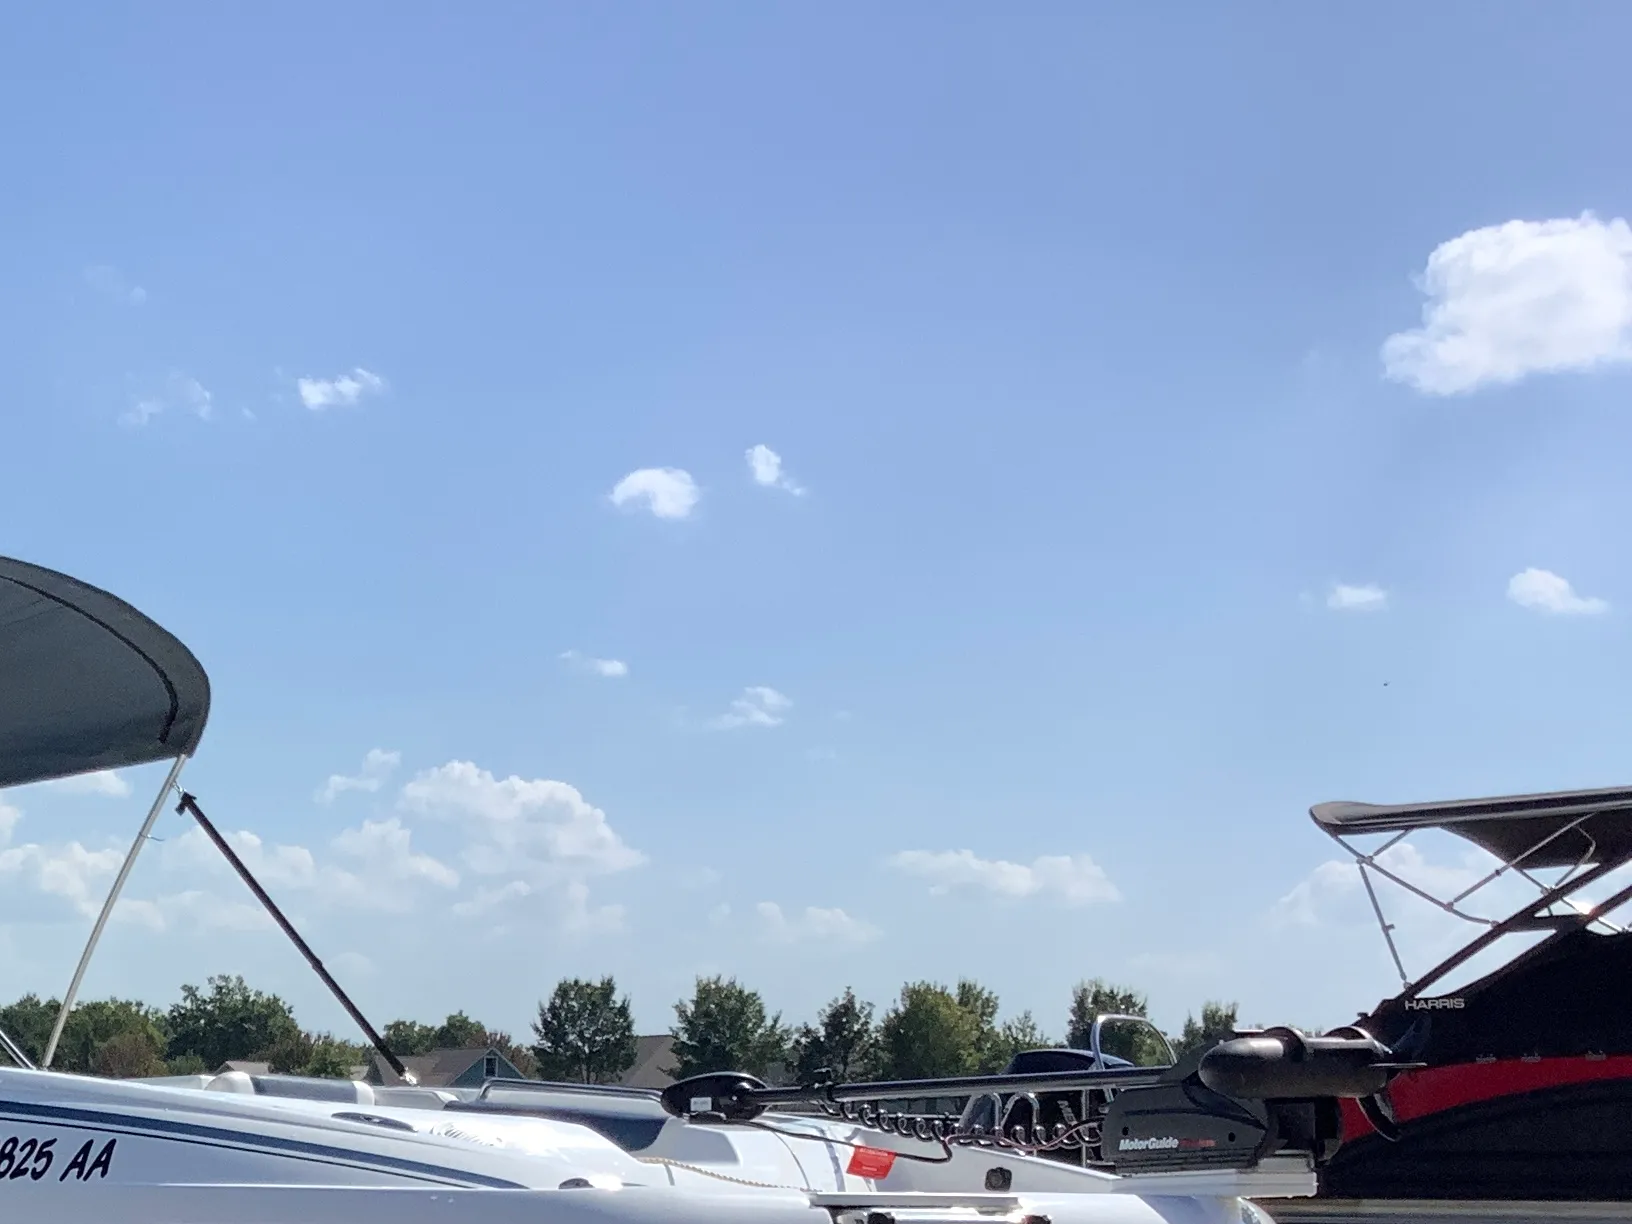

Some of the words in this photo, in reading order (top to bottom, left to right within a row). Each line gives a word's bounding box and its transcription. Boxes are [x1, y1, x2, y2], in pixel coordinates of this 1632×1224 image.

[1404, 998, 1466, 1011] HARRIS
[1118, 1136, 1180, 1151] MotorGuide
[59, 1138, 117, 1182] AA
